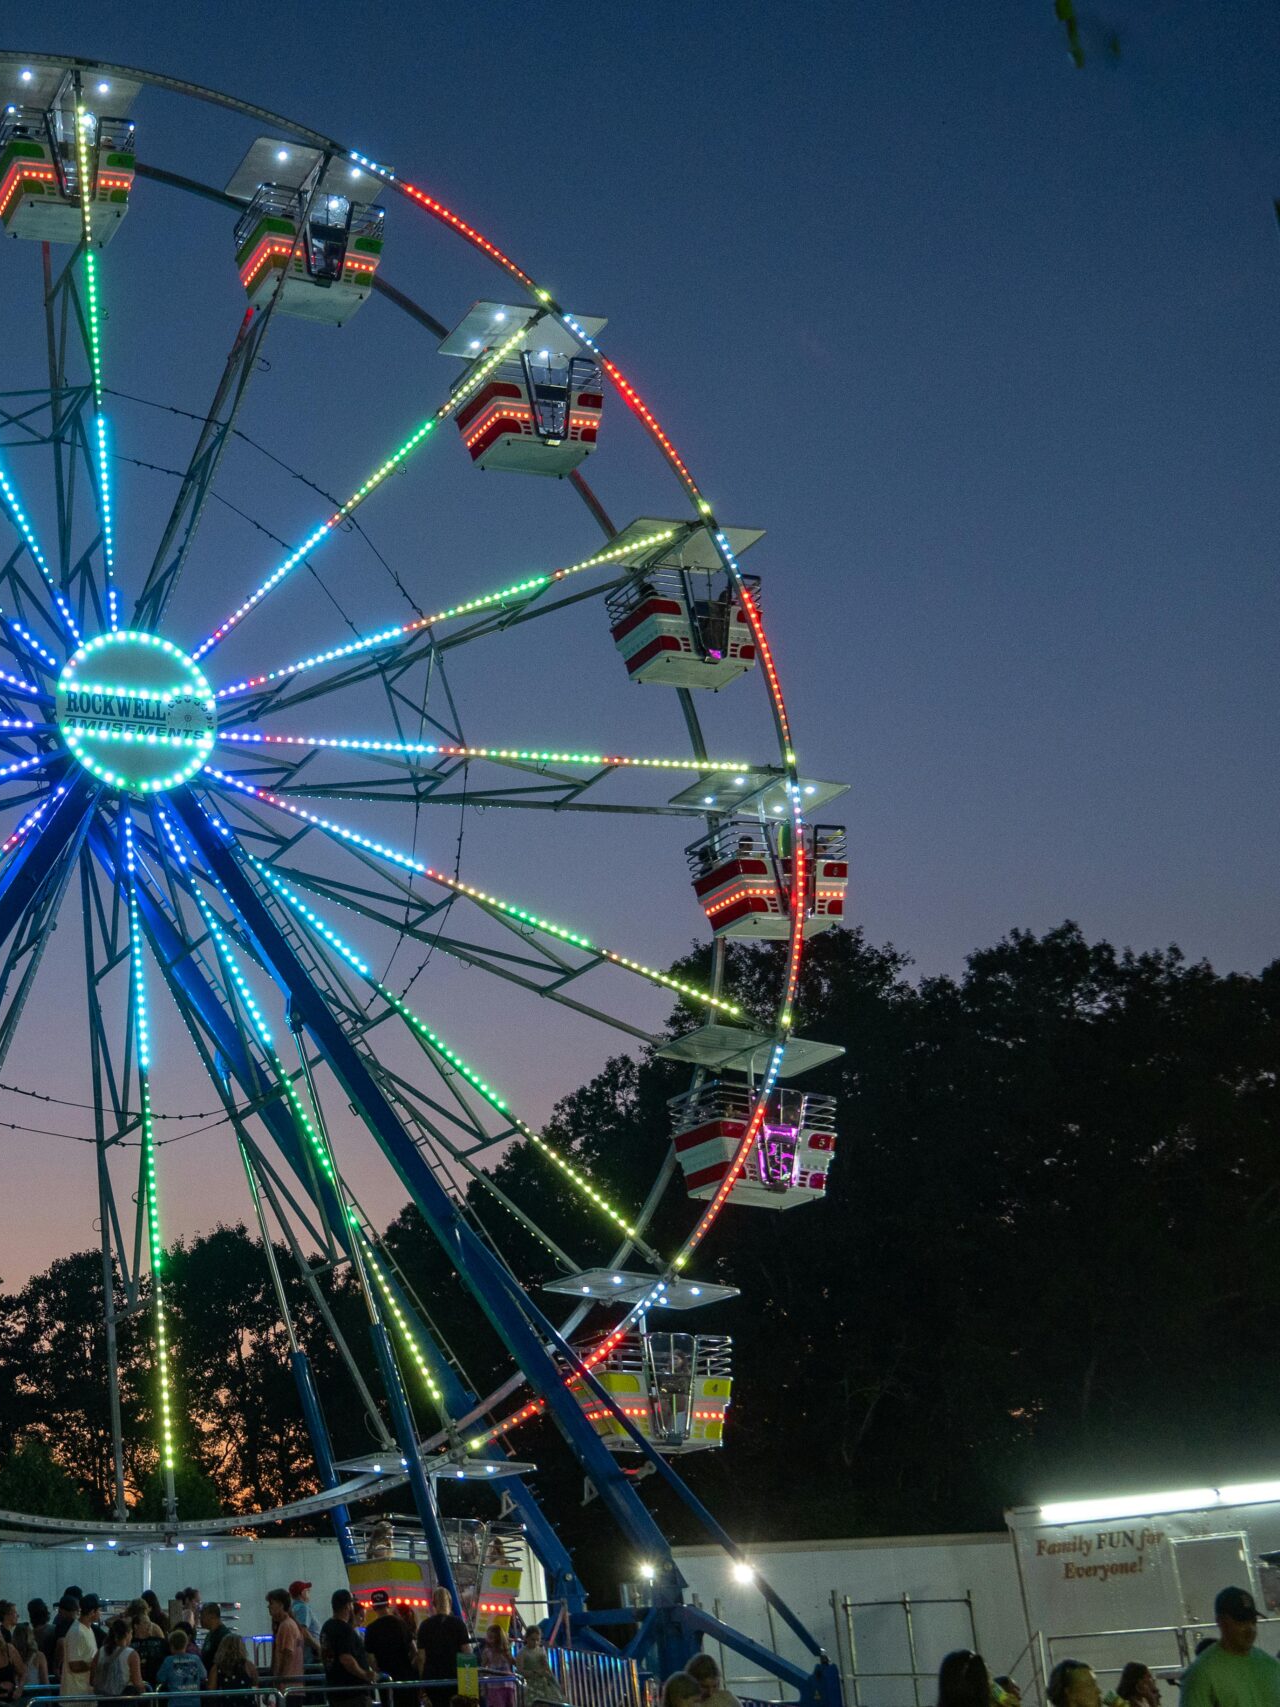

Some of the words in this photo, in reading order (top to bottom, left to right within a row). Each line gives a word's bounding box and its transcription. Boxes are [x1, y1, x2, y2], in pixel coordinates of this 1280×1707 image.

[66, 691, 167, 721] ROCKWELL
[65, 717, 205, 740] AMUSEMENTS
[1036, 1535, 1092, 1556] Family
[1096, 1530, 1136, 1549] FUN
[1137, 1528, 1164, 1551] for
[1064, 1556, 1143, 1581] Everyone!
